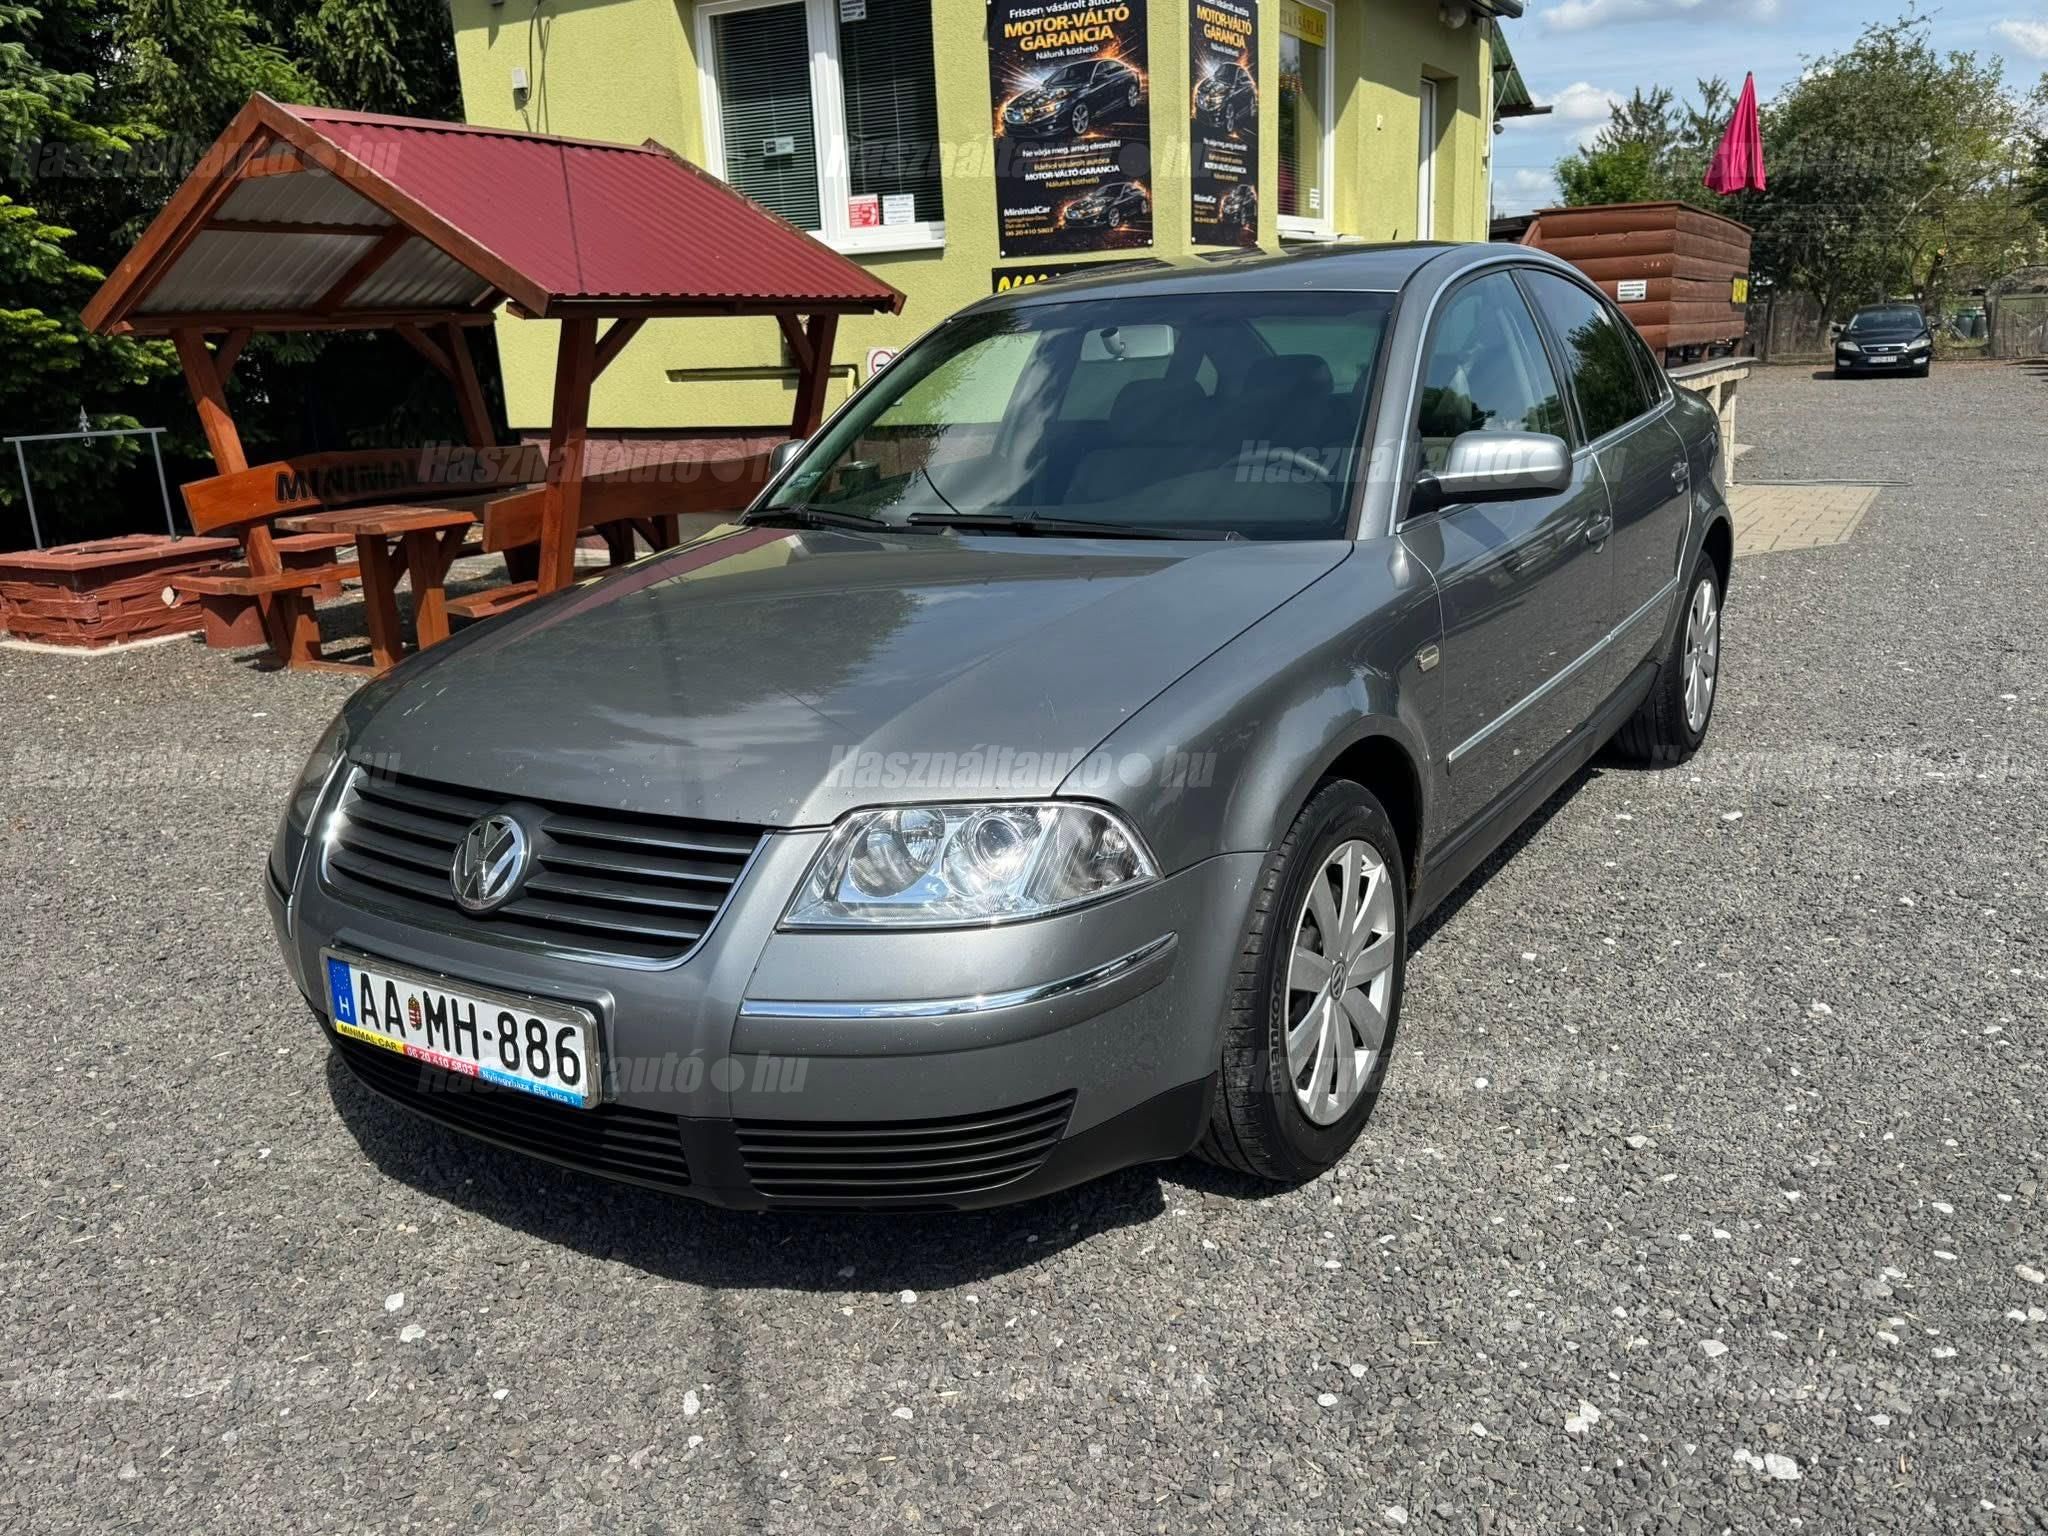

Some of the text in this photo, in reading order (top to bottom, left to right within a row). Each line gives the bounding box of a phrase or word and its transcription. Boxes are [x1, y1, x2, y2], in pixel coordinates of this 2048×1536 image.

[1003, 3, 1130, 38] MOTOR-VÁLTÓ
[1009, 6, 1044, 19] Frissen
[1196, 4, 1253, 36] MOTOR-VÁLTÓ
[1019, 25, 1115, 52] GARANCIA
[1203, 23, 1247, 49] GARANCIA
[1035, 44, 1099, 60] Nálunk köthető
[1079, 164, 1120, 176] GARANCIA
[338, 971, 581, 1087] H AA MH-886
[340, 1023, 378, 1045] MINIMAL
[420, 1050, 431, 1062] 20
[432, 1055, 449, 1069] 410
